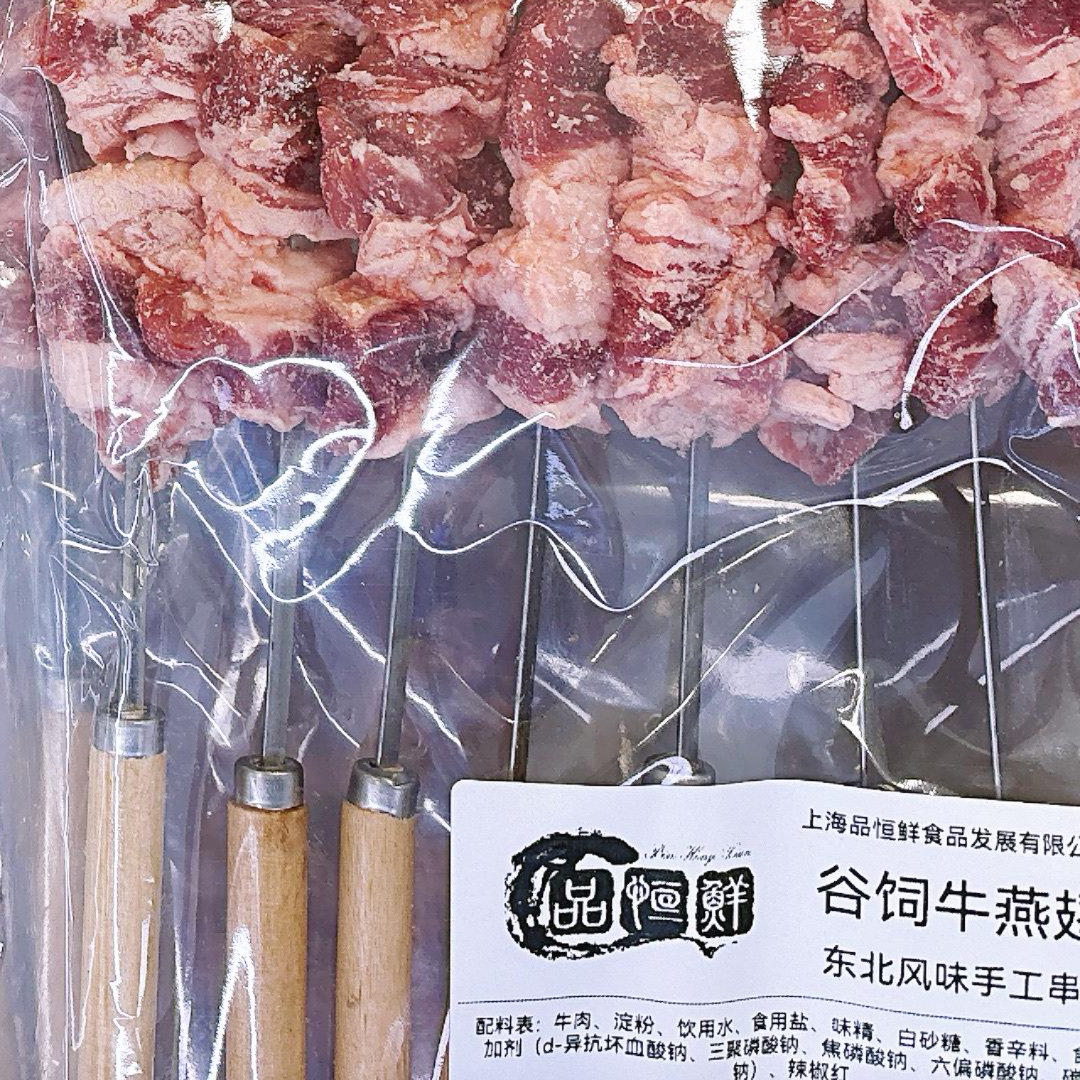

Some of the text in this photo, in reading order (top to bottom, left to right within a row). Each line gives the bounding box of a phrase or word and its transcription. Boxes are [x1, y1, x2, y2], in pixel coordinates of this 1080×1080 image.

[822, 944, 1080, 1005] 东北风味手工串
